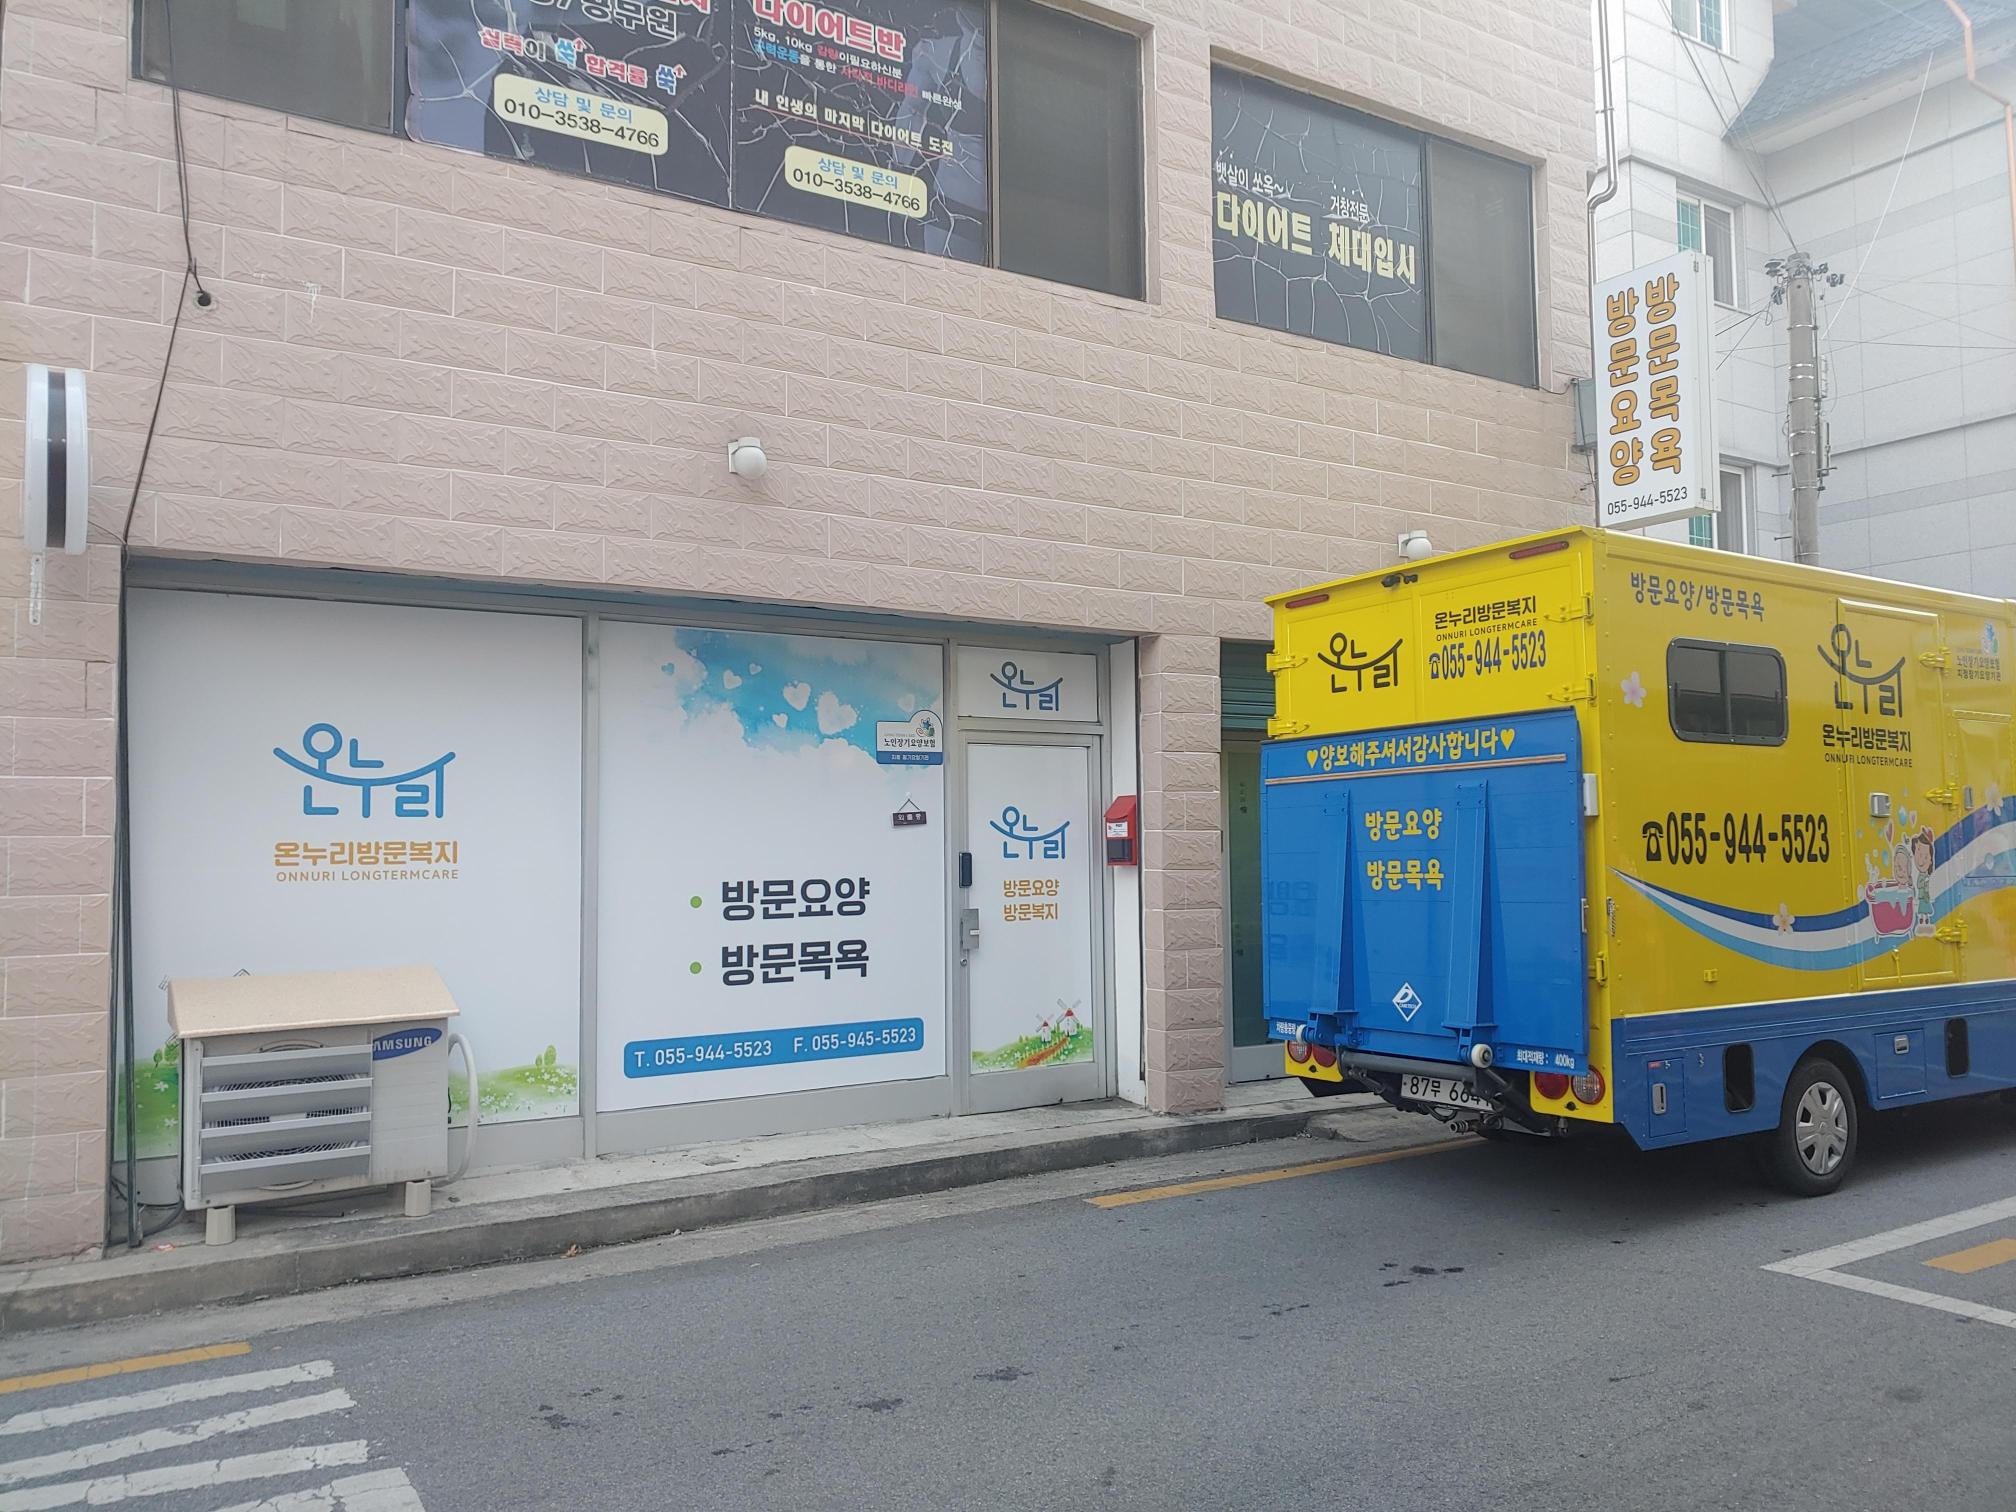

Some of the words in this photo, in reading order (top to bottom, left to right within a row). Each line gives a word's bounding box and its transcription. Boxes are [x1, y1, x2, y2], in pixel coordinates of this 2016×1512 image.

[478, 26, 547, 62] 실력이
[584, 53, 648, 88] 합격률
[785, 36, 813, 52] 10kg
[815, 58, 837, 74] 통한
[535, 86, 568, 107] 상담
[576, 96, 592, 113] 및
[600, 102, 632, 123] 문의
[754, 88, 769, 107] 내
[775, 94, 818, 119] 인생의
[824, 107, 865, 132] 마지막
[871, 121, 923, 149] 다이어트
[929, 136, 954, 156] 도전
[504, 99, 660, 148] 010-3538-4766
[793, 168, 920, 211] 010-3538-4766
[818, 157, 845, 175] 상담
[851, 166, 864, 180] 및
[871, 170, 898, 189] 문의
[1216, 160, 1249, 190] 뱃살이
[1216, 190, 1313, 256] 다이어트
[1330, 194, 1371, 224] 거창전문
[1328, 221, 1415, 285] 체대입시
[1606, 287, 1644, 487] 방문요양
[1645, 272, 1683, 475] 방문목욕
[1606, 486, 1689, 516] 055-944-5523
[1434, 595, 1537, 631] 온누리방문복지
[1630, 571, 1765, 622] 방문요양/방문목욕
[1436, 629, 1468, 642] ONNURI
[1469, 617, 1539, 638] LONGTERMCARE
[1441, 629, 1548, 681] 055-944-5523
[1318, 727, 1499, 772] 양보해주셔서감사합니다
[1822, 723, 1912, 753] 온누리방문복지
[1857, 755, 1913, 768] LONGTERMCARE
[1364, 807, 1443, 841] 방문요양
[1665, 811, 1831, 866] 055-944-5523
[274, 840, 458, 867] 온누리방문복지
[276, 870, 336, 882] ONNURI
[342, 868, 459, 881] LONGTERMCARE
[1003, 878, 1060, 899] 방문요양
[1366, 858, 1445, 892] 방문목욕
[721, 876, 871, 922] 방문요양
[1003, 903, 1058, 922] 방문복지
[721, 939, 870, 986] 방문목욕
[634, 1050, 650, 1068] T.
[655, 1040, 772, 1067] 055-944-5523
[793, 1036, 808, 1053] F.
[812, 1027, 916, 1051] 055-945-5523
[1555, 1053, 1576, 1069] 400kg
[1410, 1076, 1441, 1097] 87무
